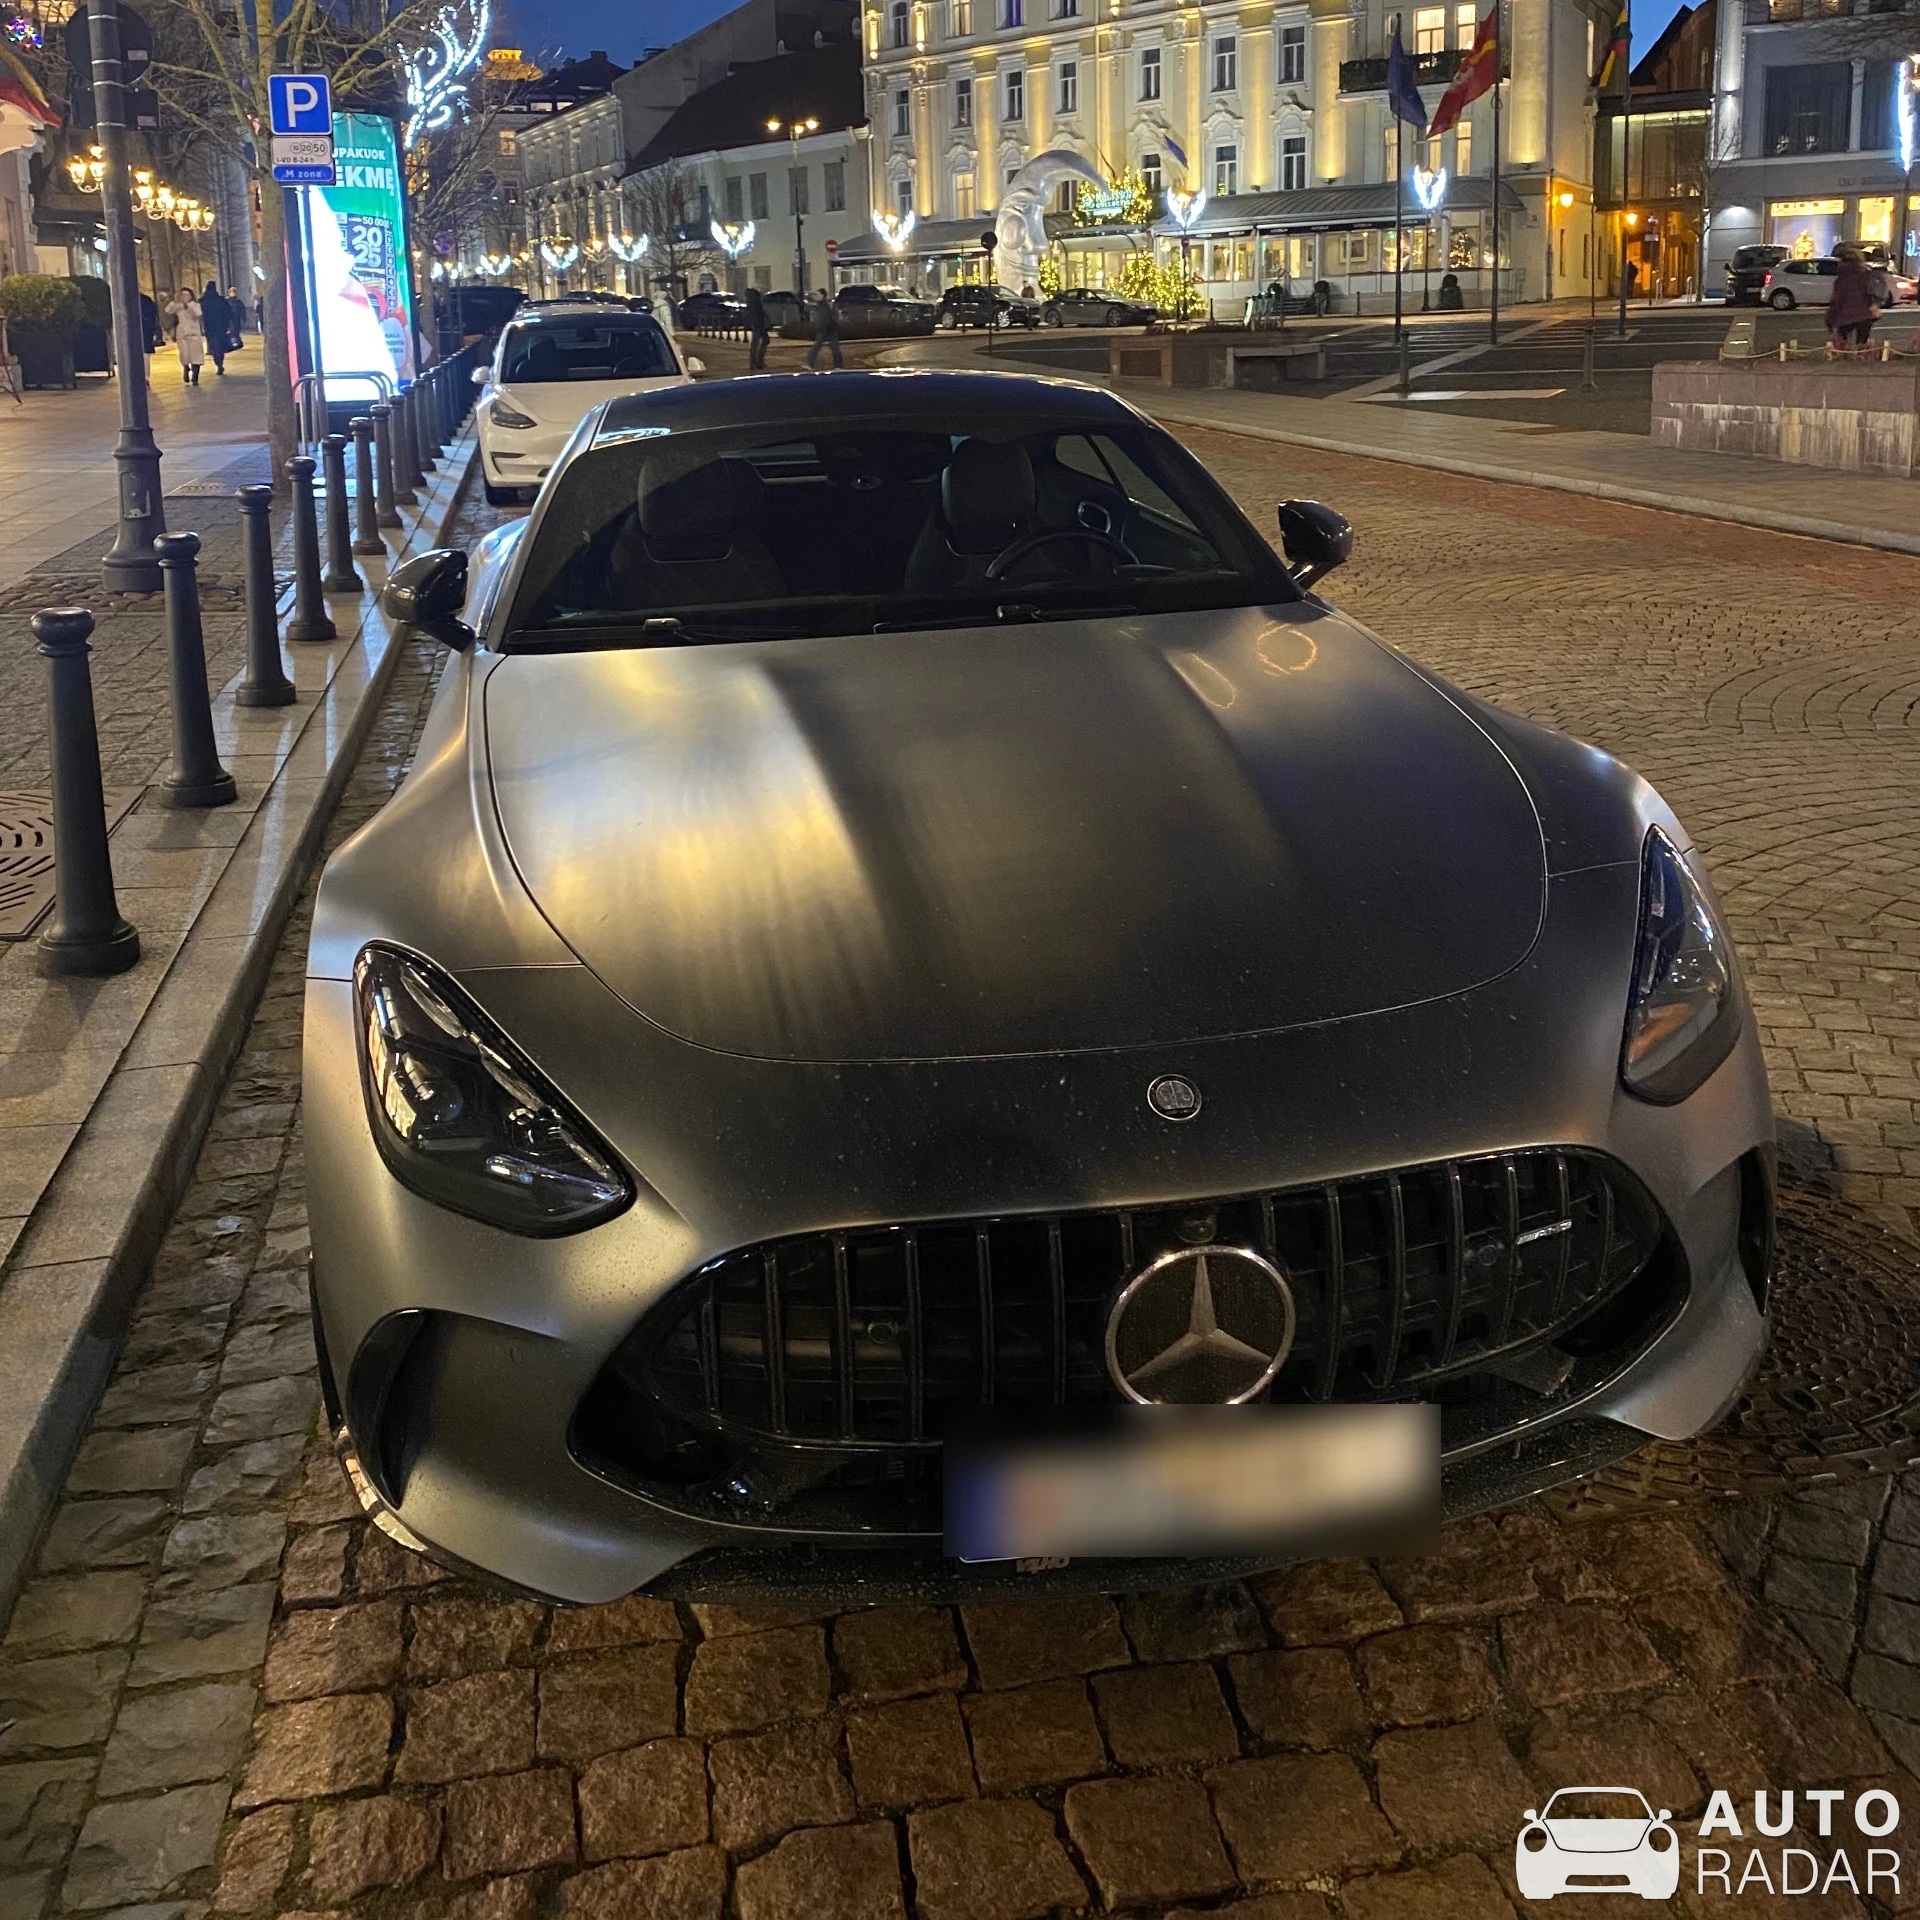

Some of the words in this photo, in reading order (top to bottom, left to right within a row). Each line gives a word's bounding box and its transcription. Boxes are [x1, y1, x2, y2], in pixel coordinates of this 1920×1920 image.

[285, 82, 318, 128] P
[313, 144, 326, 153] 50
[285, 170, 294, 178] M
[362, 216, 374, 226] 50
[351, 225, 382, 248] 20
[353, 243, 382, 268] 25
